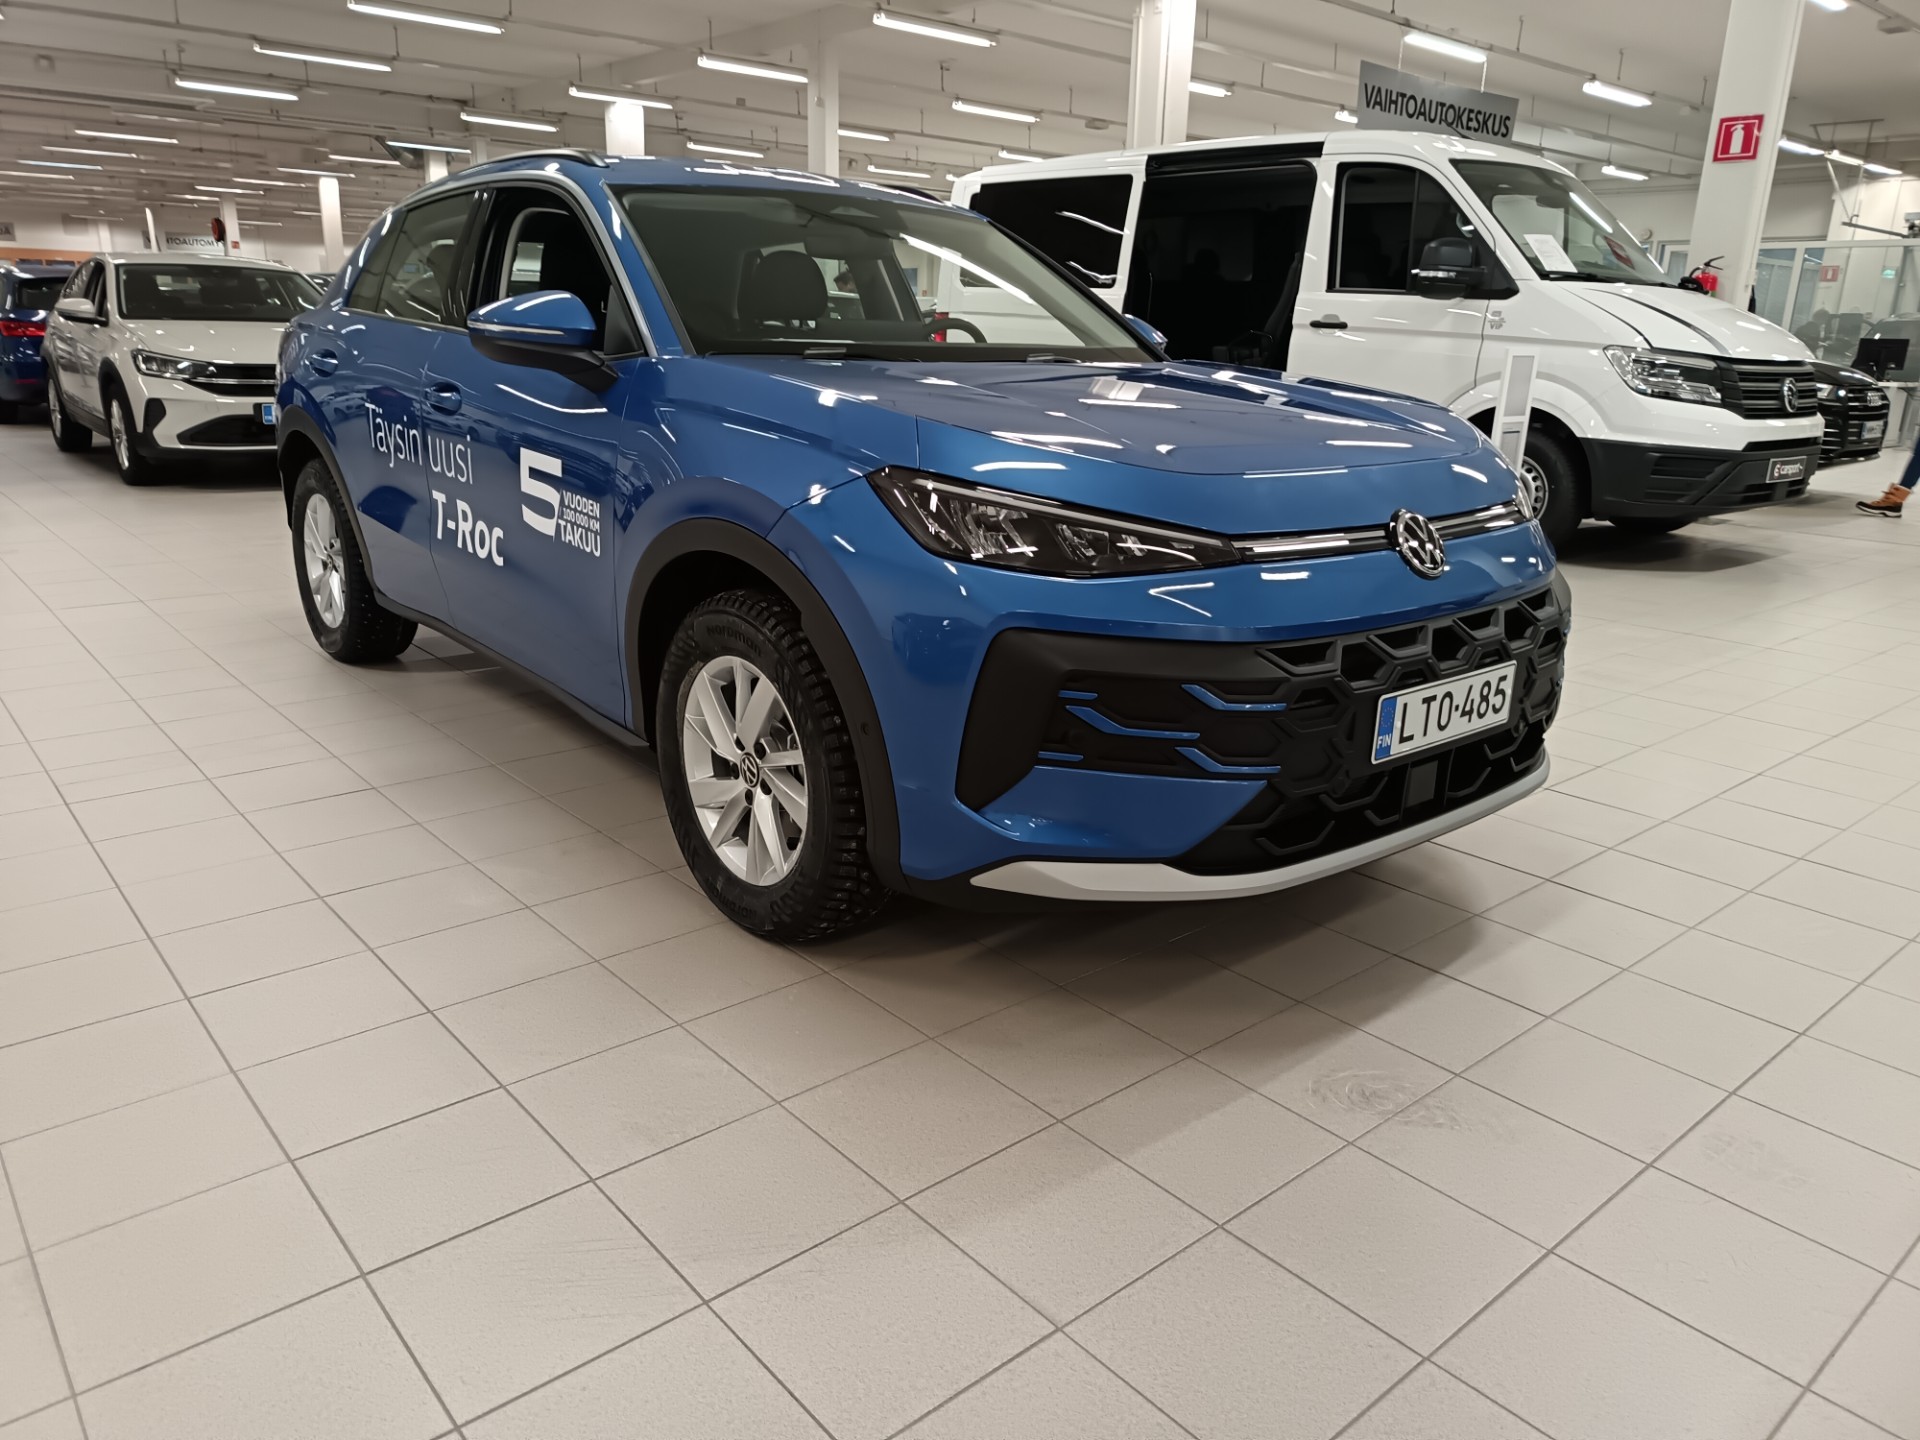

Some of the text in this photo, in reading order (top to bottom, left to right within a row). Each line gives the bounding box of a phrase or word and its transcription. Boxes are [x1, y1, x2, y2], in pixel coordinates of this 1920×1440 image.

[1364, 83, 1511, 138] VAIHTOAUTOKESKUS
[364, 402, 473, 485] Täysin uusi
[520, 447, 562, 538] 5
[562, 490, 600, 518] VUODEN
[558, 519, 600, 557] TAKUU
[589, 519, 600, 533] KM
[1377, 674, 1508, 750] FIN LTO-485
